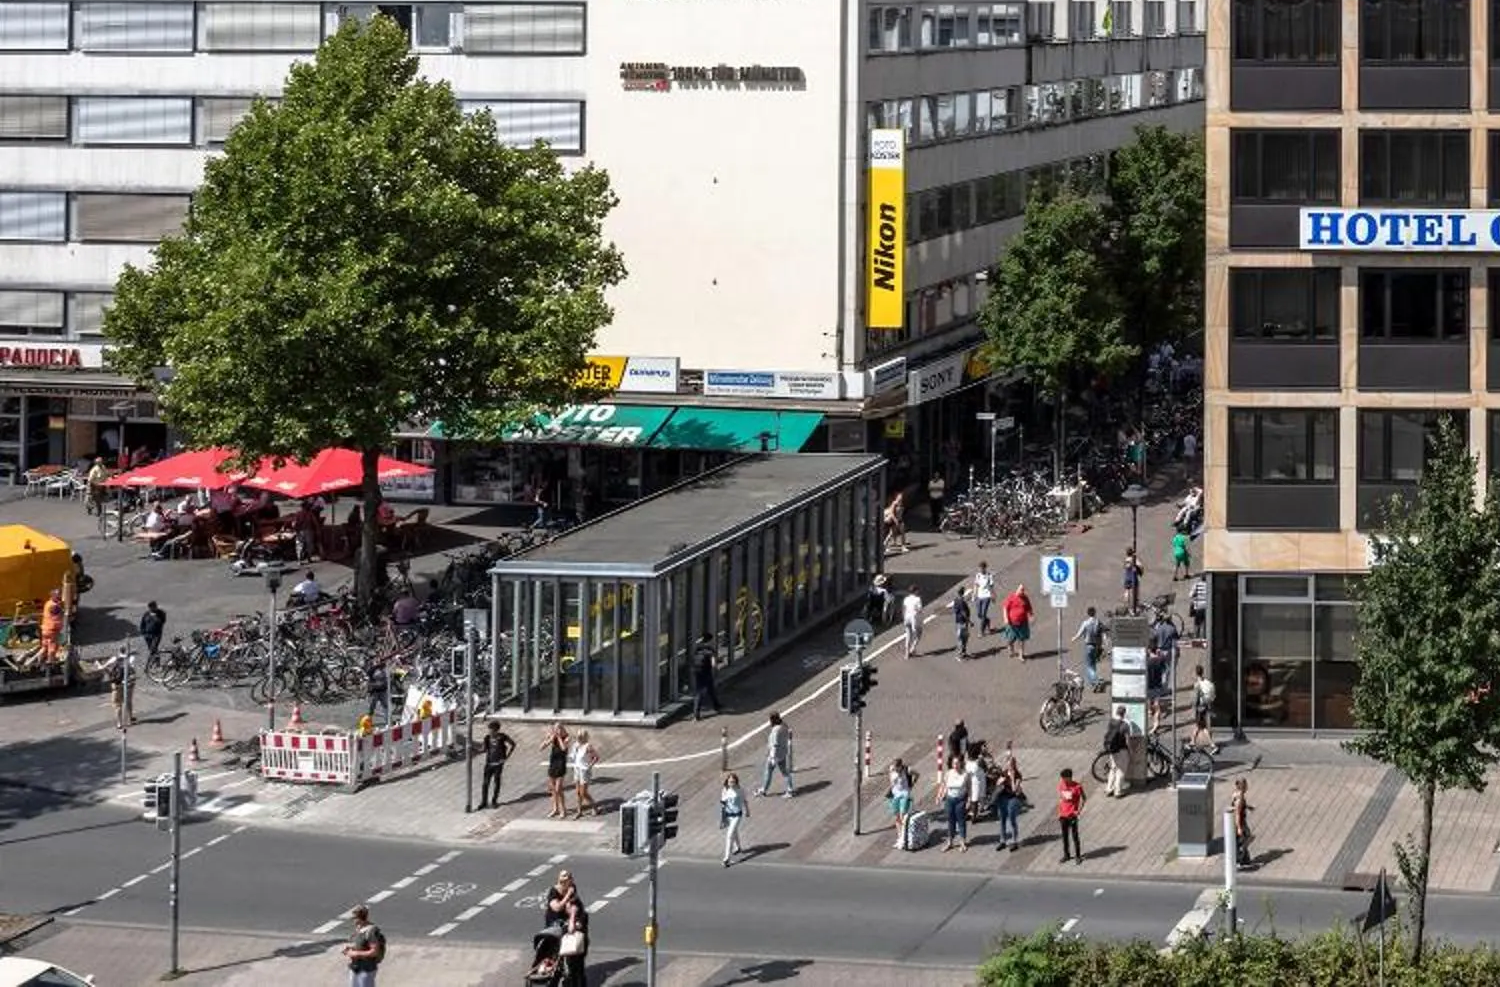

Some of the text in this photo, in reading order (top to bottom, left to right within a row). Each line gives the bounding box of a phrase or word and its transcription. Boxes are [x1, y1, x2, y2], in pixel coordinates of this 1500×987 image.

[1307, 212, 1477, 246] HOTEL
[874, 201, 897, 292] Nikon
[920, 366, 955, 394] SONY
